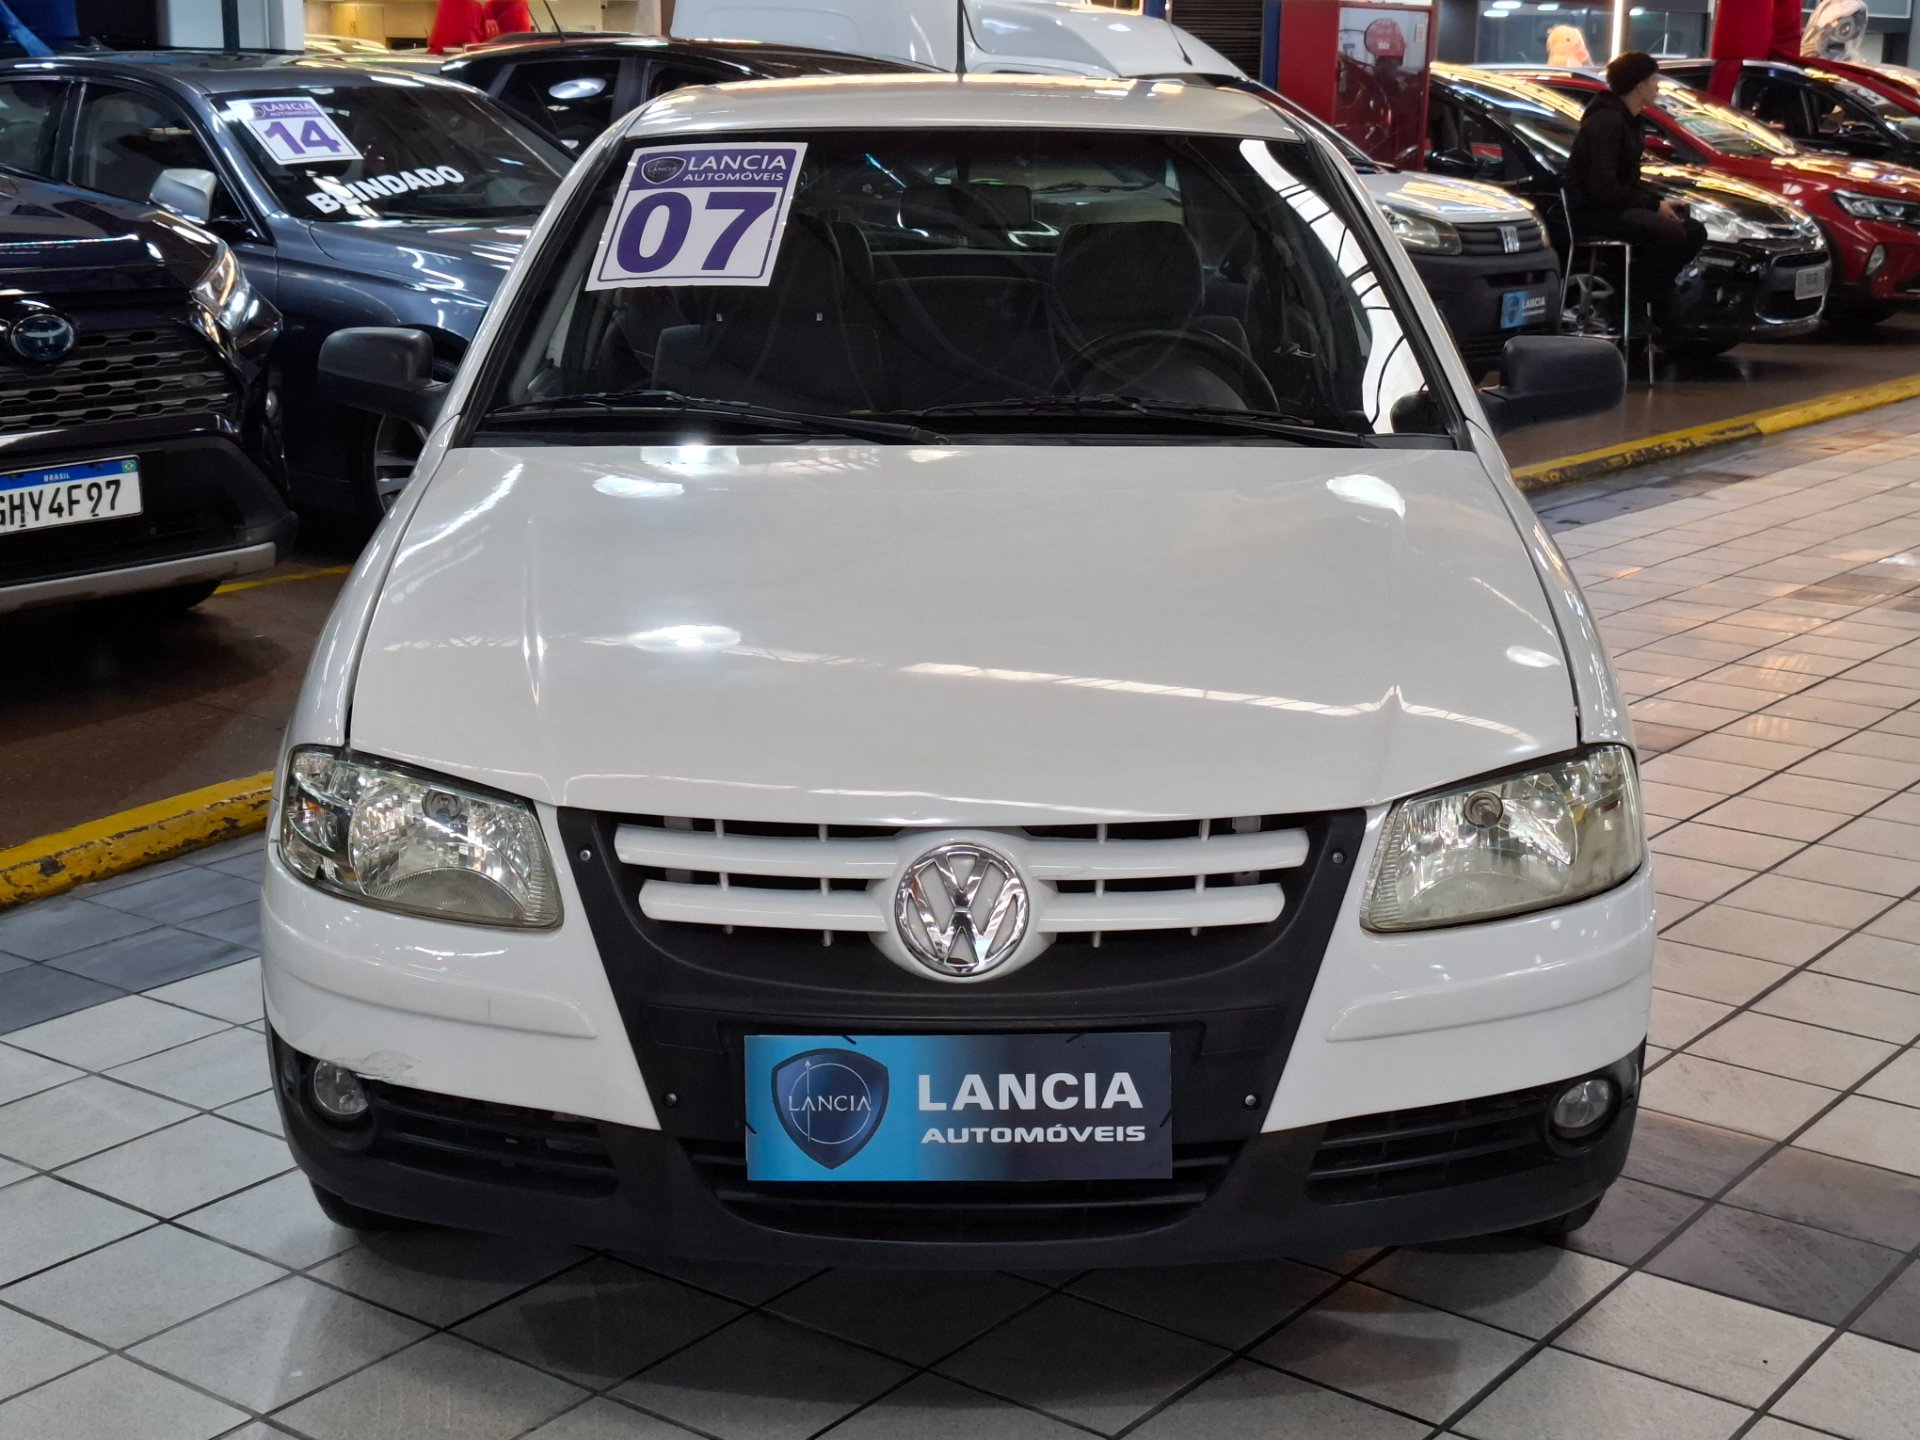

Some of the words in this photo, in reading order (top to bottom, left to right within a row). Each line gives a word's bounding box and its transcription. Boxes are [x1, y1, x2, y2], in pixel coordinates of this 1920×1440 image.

[263, 102, 316, 112] LANCIA
[264, 120, 342, 155] 14
[687, 154, 787, 171] LANCIA
[683, 171, 784, 182] AUTOMÓVEIS
[616, 191, 777, 274] 07
[43, 472, 71, 483] BRASIL
[918, 1072, 1143, 1112] LANCIA
[788, 1095, 872, 1113] LANCIA
[920, 1123, 1146, 1145] AUTOMÓVEIS
